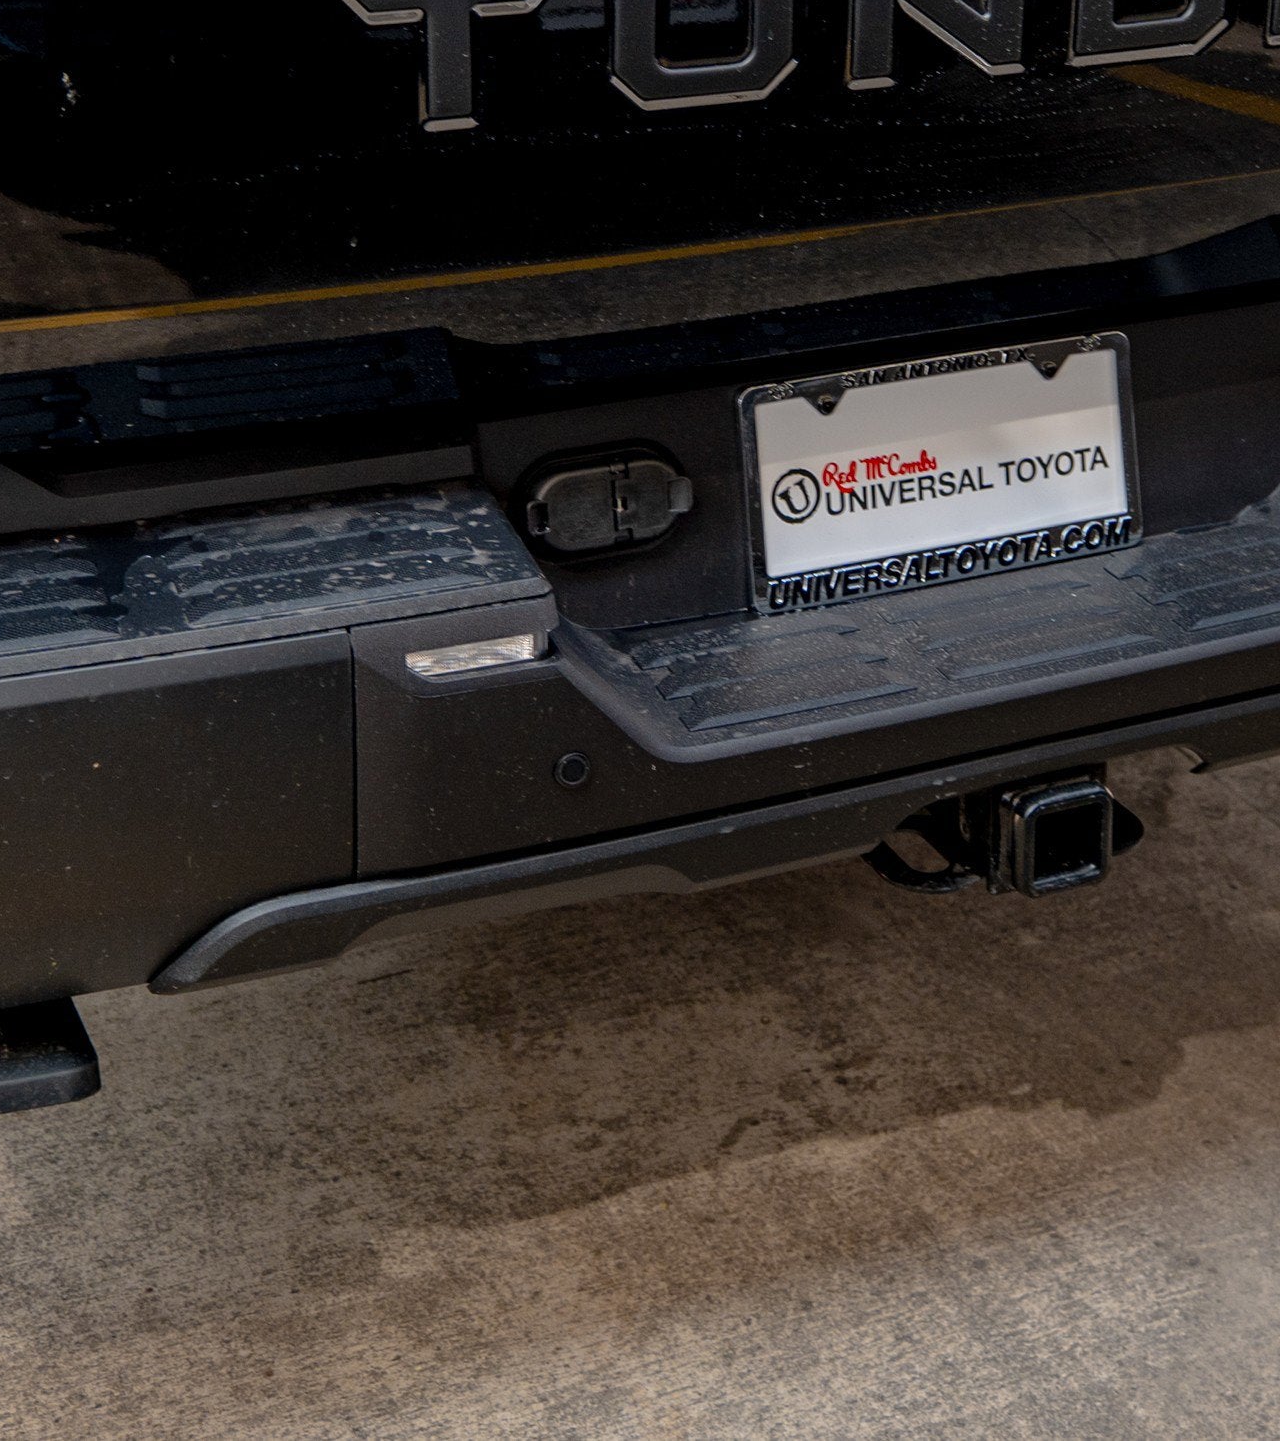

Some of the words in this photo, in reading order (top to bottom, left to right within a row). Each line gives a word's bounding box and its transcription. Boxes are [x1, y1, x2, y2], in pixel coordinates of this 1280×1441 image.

[841, 369, 886, 390] SAN
[822, 460, 858, 494] Red
[859, 448, 938, 481] McCombs
[825, 465, 995, 516] UNIVERSAL
[998, 445, 1110, 486] TOYOTA
[766, 514, 1134, 611] UNIVERSALTOYOTA.COM
